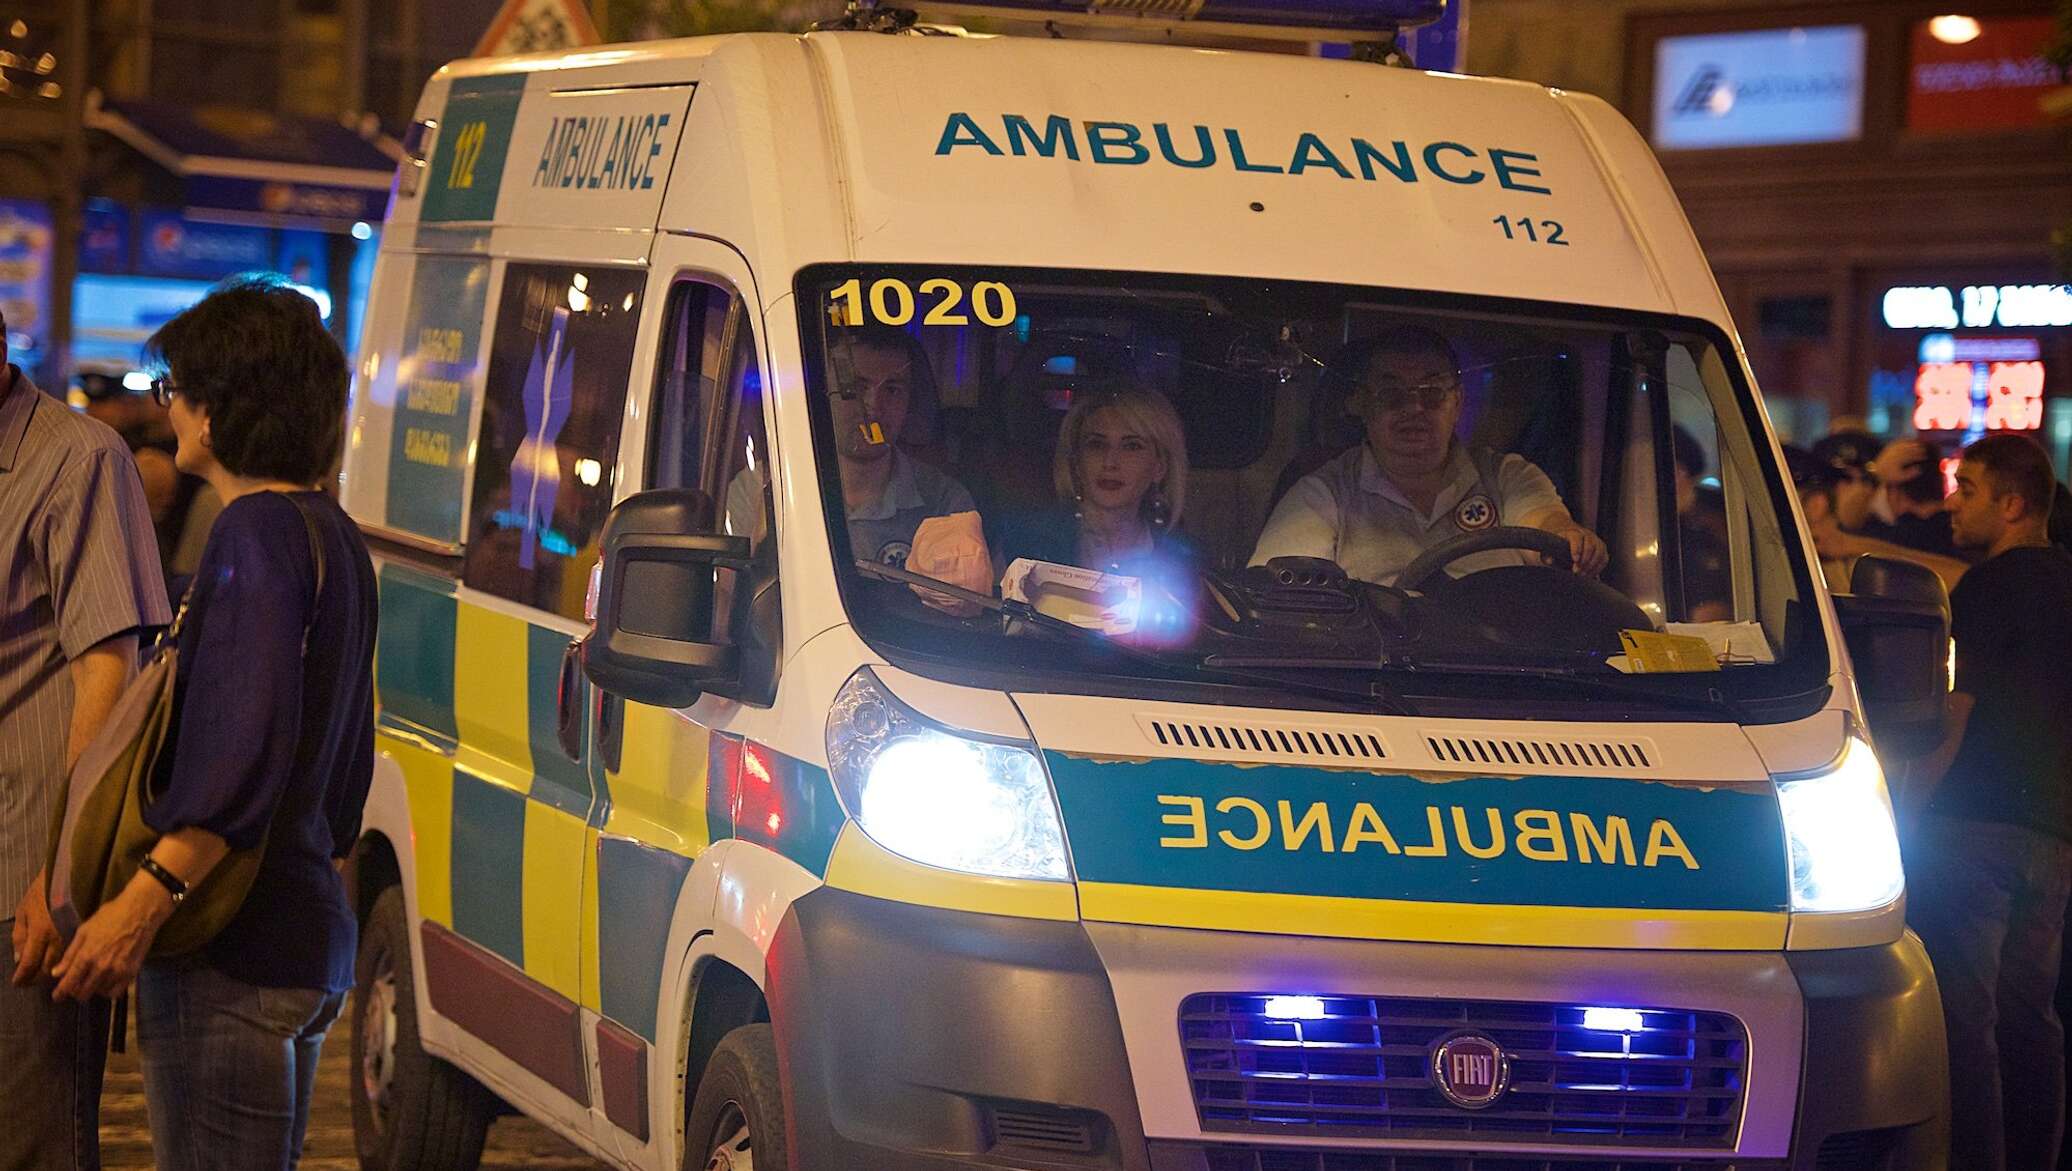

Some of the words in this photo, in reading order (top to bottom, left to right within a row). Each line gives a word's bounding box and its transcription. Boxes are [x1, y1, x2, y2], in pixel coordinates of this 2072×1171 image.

[448, 121, 486, 188] 112
[532, 114, 670, 189] AMBULANCE
[936, 112, 1551, 195] AMBULANCE
[1493, 214, 1569, 246] 112
[829, 278, 1016, 327] 1020
[1453, 1054, 1491, 1086] FIAT
